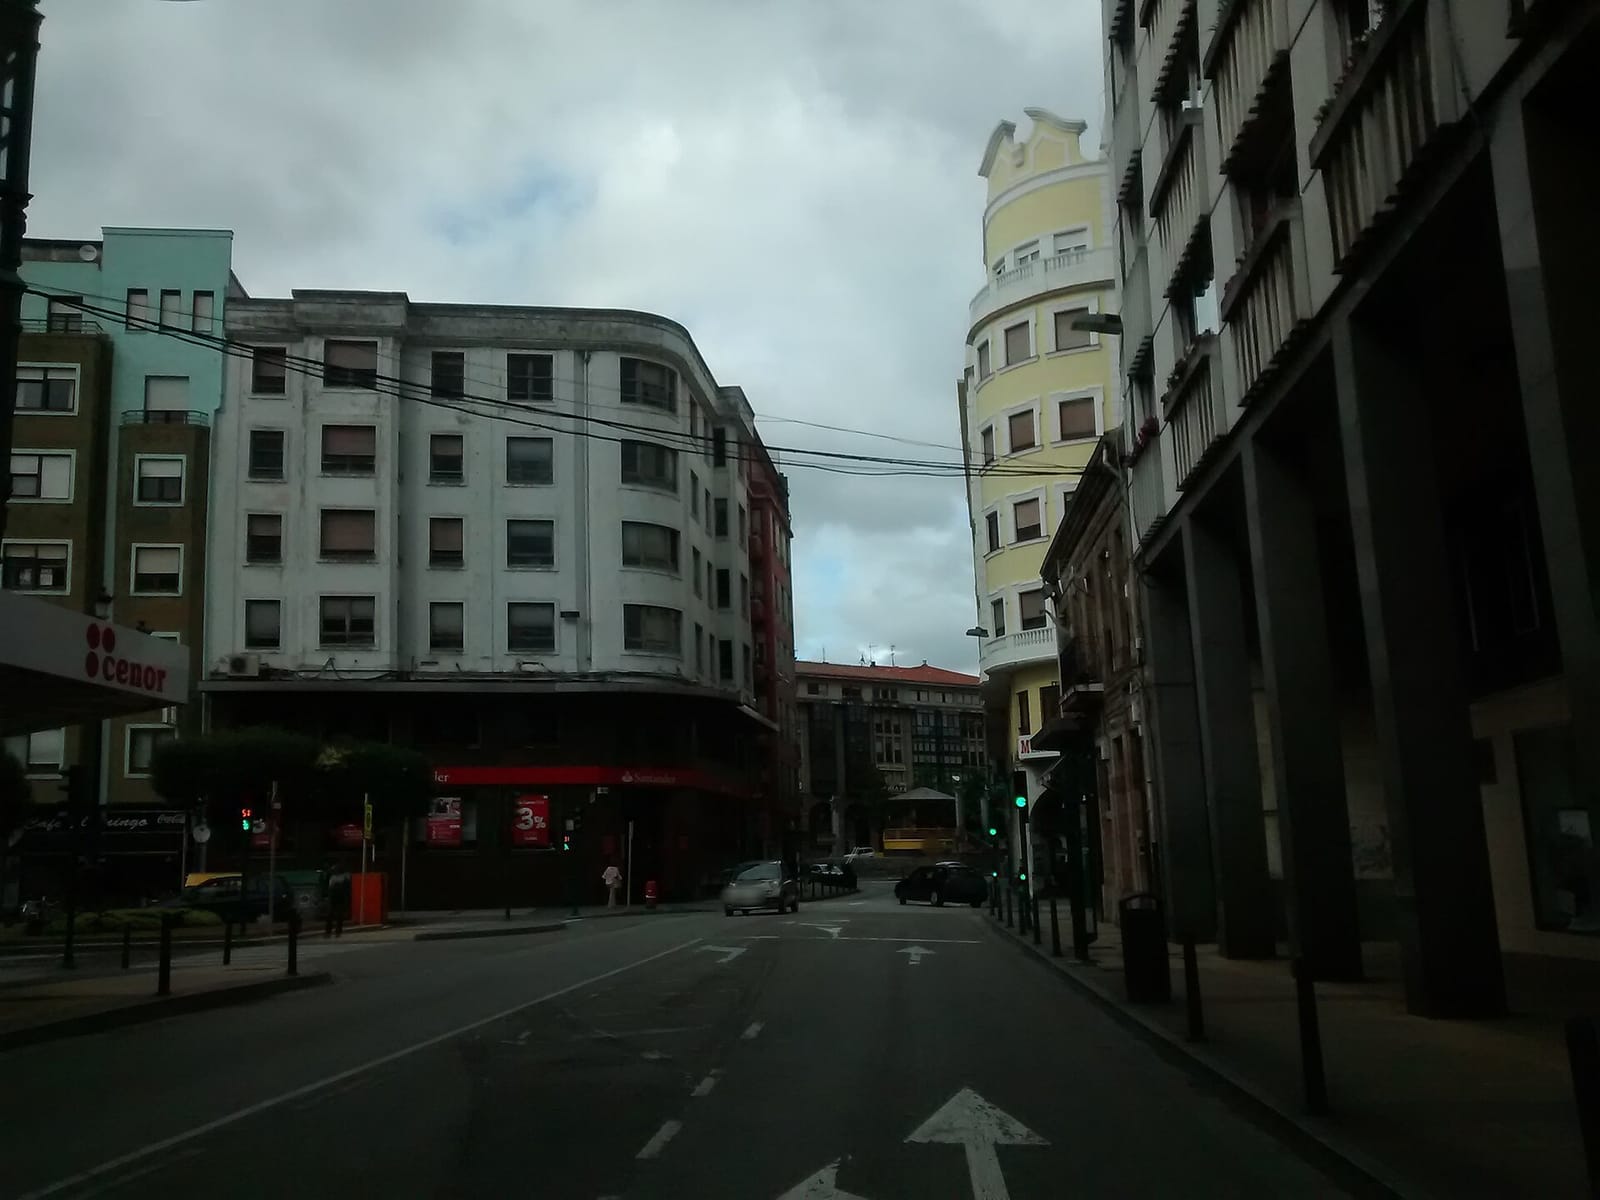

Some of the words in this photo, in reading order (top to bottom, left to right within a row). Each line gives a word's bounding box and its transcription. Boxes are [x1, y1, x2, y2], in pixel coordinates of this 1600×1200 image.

[102, 655, 167, 692] cenor
[634, 772, 677, 784] Santander
[515, 807, 547, 831] 3%
